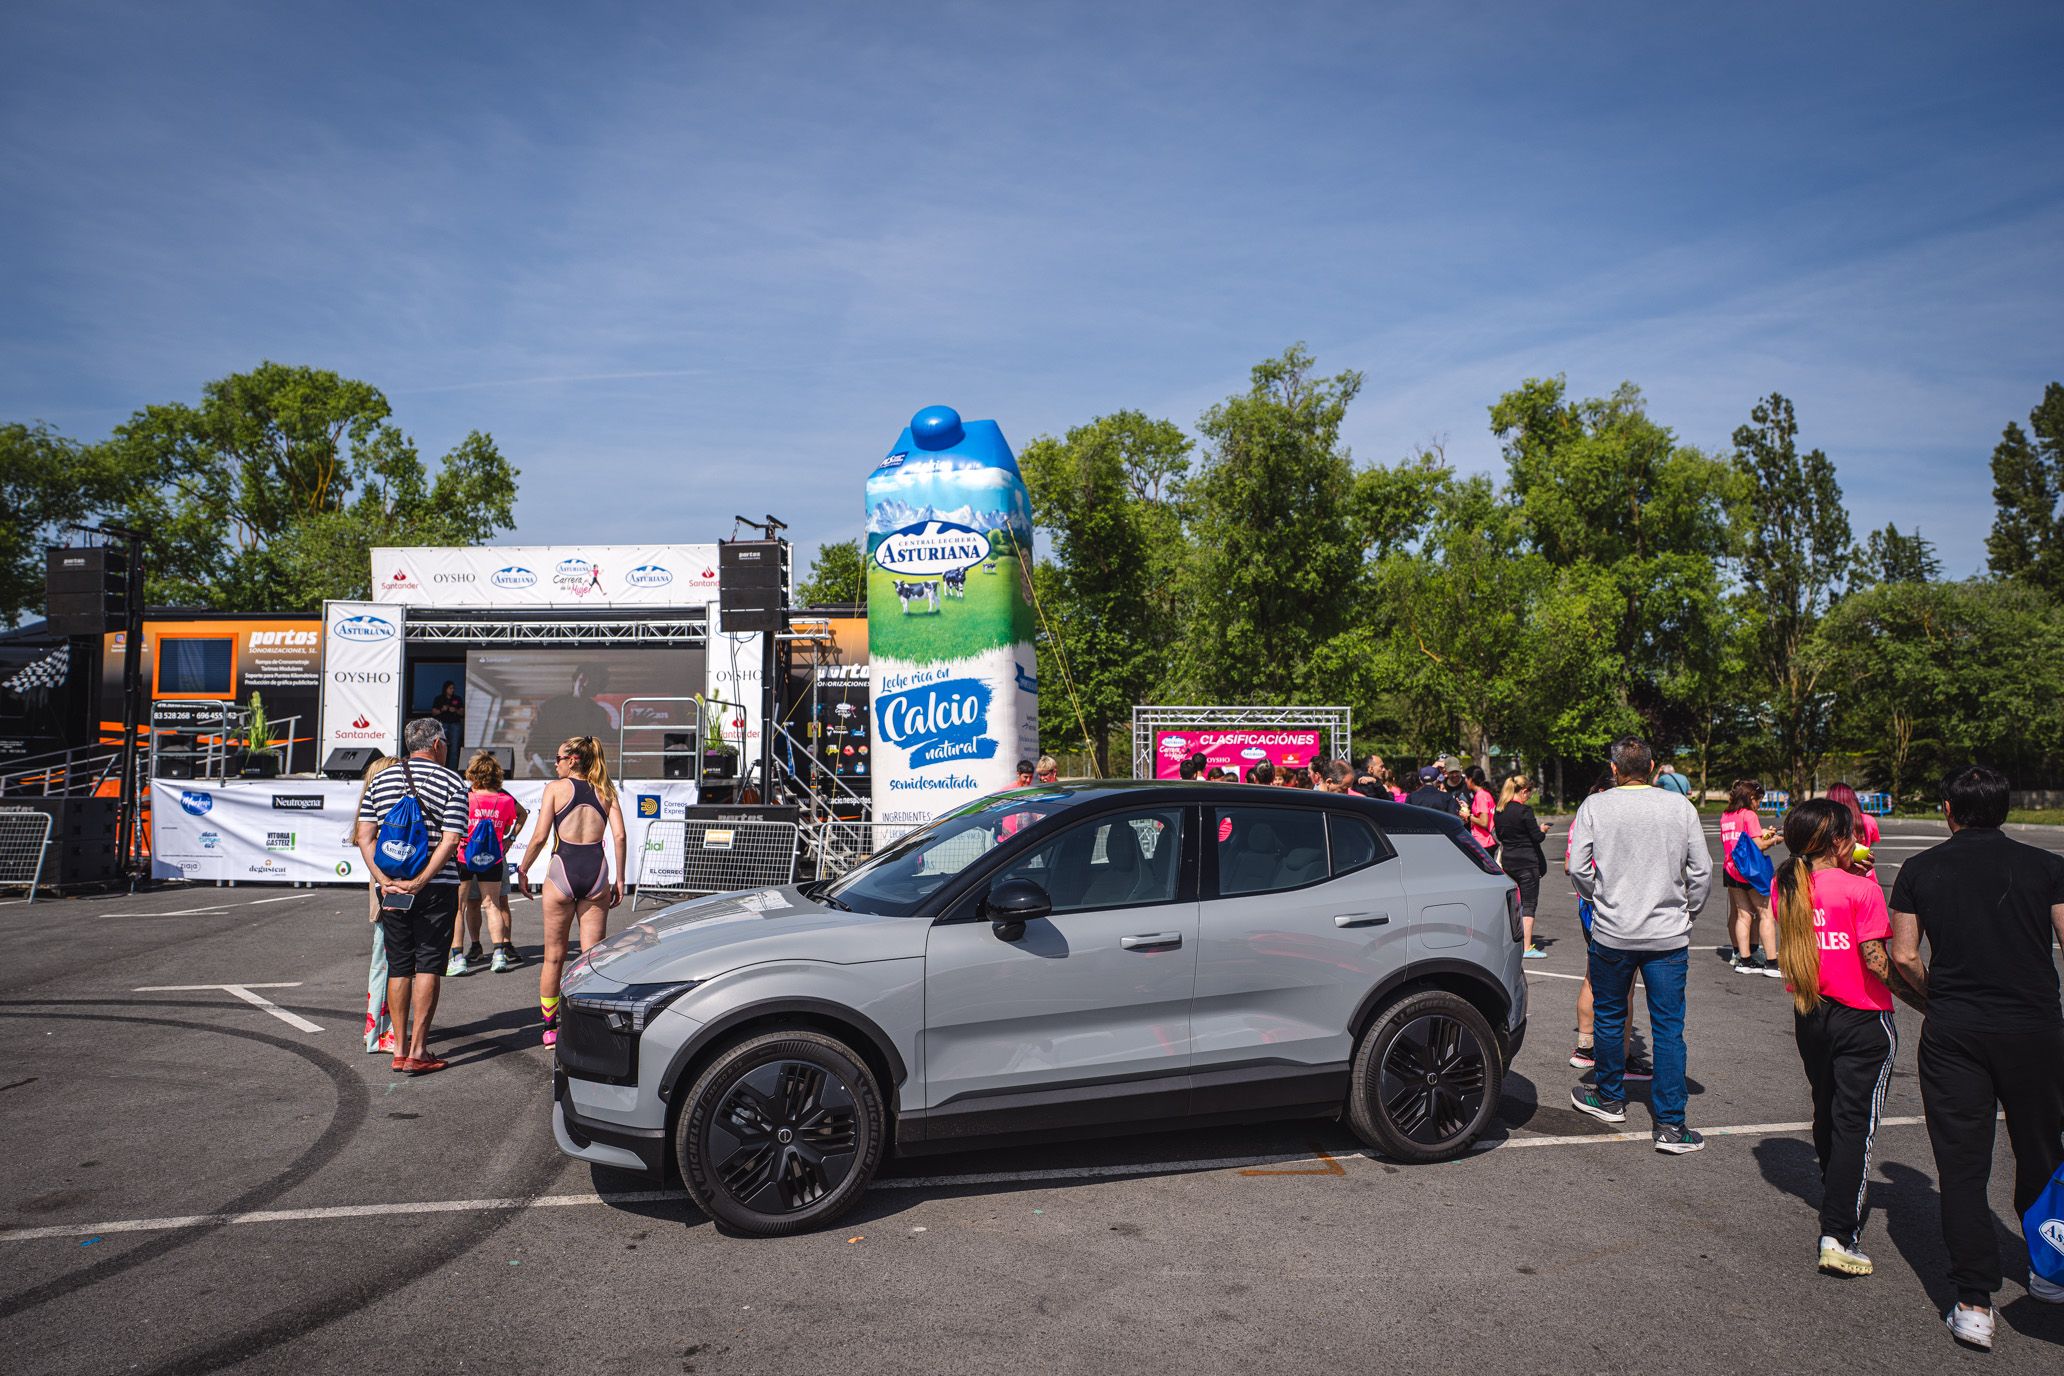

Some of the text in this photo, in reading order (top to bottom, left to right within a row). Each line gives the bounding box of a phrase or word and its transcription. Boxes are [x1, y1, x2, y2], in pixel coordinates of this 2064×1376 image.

[898, 536, 977, 547] CENTRAL LECHERA
[881, 543, 981, 565] ASTURIANA
[433, 573, 476, 583] OYSHO
[553, 575, 583, 584] Carrera
[381, 582, 419, 590] Santander
[571, 583, 591, 597] Mujer
[248, 629, 318, 648] portos
[334, 671, 391, 684] OYSHO
[716, 670, 762, 681] OYSHO
[817, 663, 870, 681] porto
[881, 668, 949, 694] Leche rica en
[884, 692, 979, 741] Calcio
[335, 730, 386, 739] Santander
[1200, 733, 1315, 745] CLASIFICACIÓNES
[925, 736, 978, 760] natural
[889, 772, 979, 791] semidesnatada
[275, 797, 321, 808] Neutrogena
[180, 863, 198, 871] ziaja
[689, 1107, 706, 1183] MICHELIN
